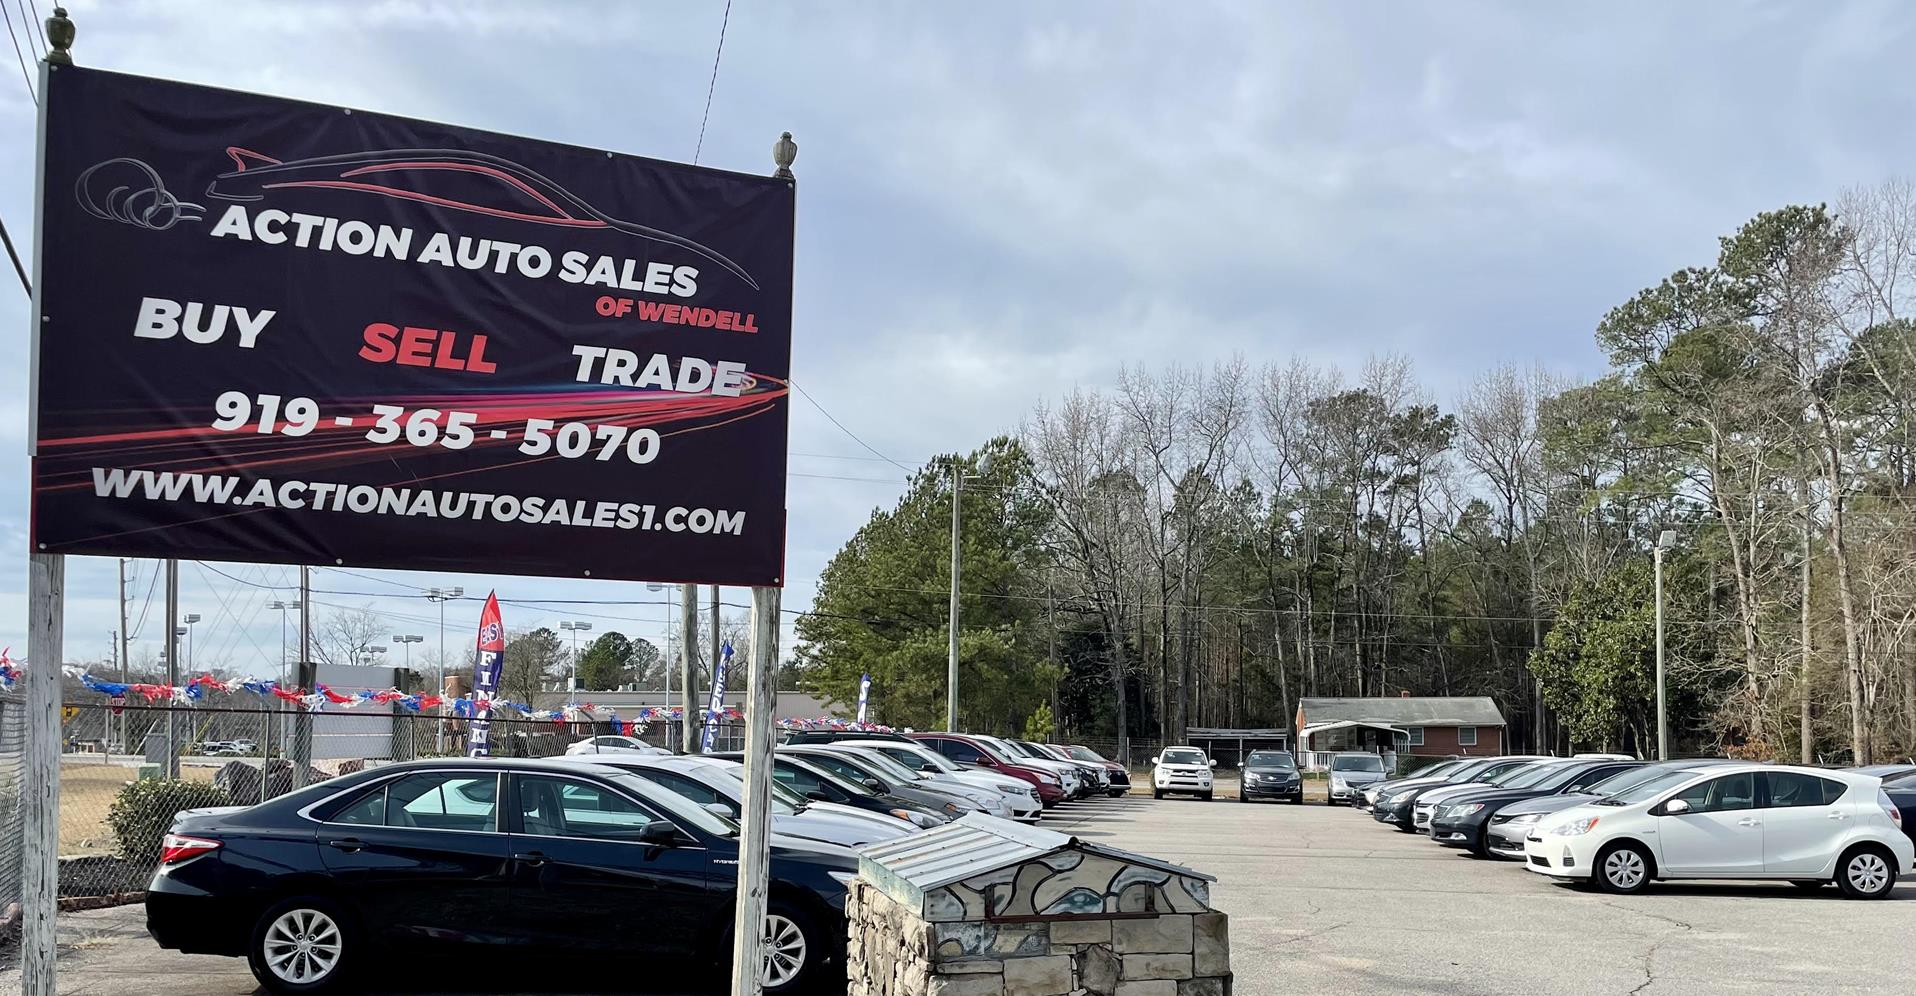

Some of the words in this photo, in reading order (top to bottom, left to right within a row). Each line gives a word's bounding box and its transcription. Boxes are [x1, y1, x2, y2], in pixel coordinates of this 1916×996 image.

[210, 204, 413, 261] ACTION
[416, 232, 552, 279] AUTO
[557, 250, 699, 298] SALES
[133, 296, 276, 349] BUY
[359, 322, 497, 373] SELL
[572, 344, 749, 398] TRADE
[595, 296, 636, 317] OF
[638, 301, 758, 333] WENDELL
[211, 391, 320, 437] 919
[364, 404, 478, 450] 365
[518, 418, 661, 465] 5070
[93, 467, 746, 536] WWW.ACTIONAUTOSALES1.COM
